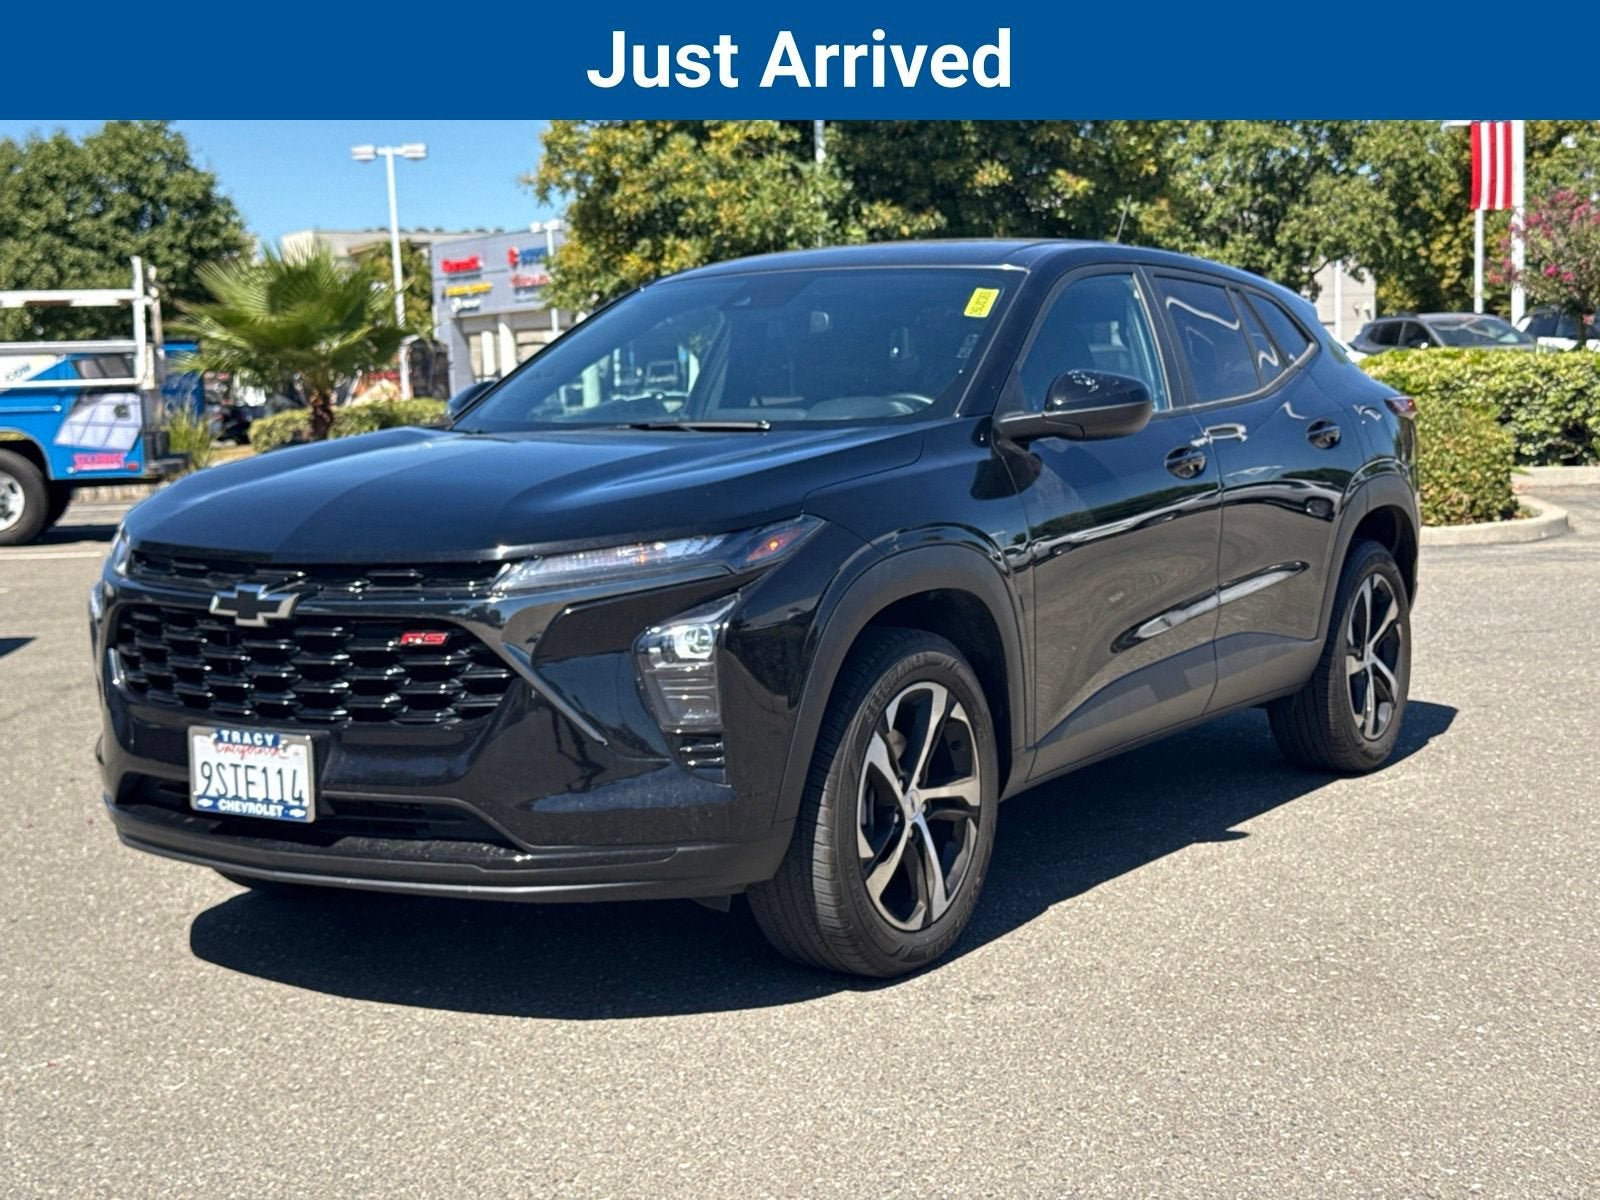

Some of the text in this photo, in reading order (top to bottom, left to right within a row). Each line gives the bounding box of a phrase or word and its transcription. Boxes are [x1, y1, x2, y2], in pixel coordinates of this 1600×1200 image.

[400, 631, 448, 646] RS
[220, 729, 275, 747] TRACY
[200, 760, 304, 804] 9STE114
[216, 798, 285, 818] CHEVROLET
